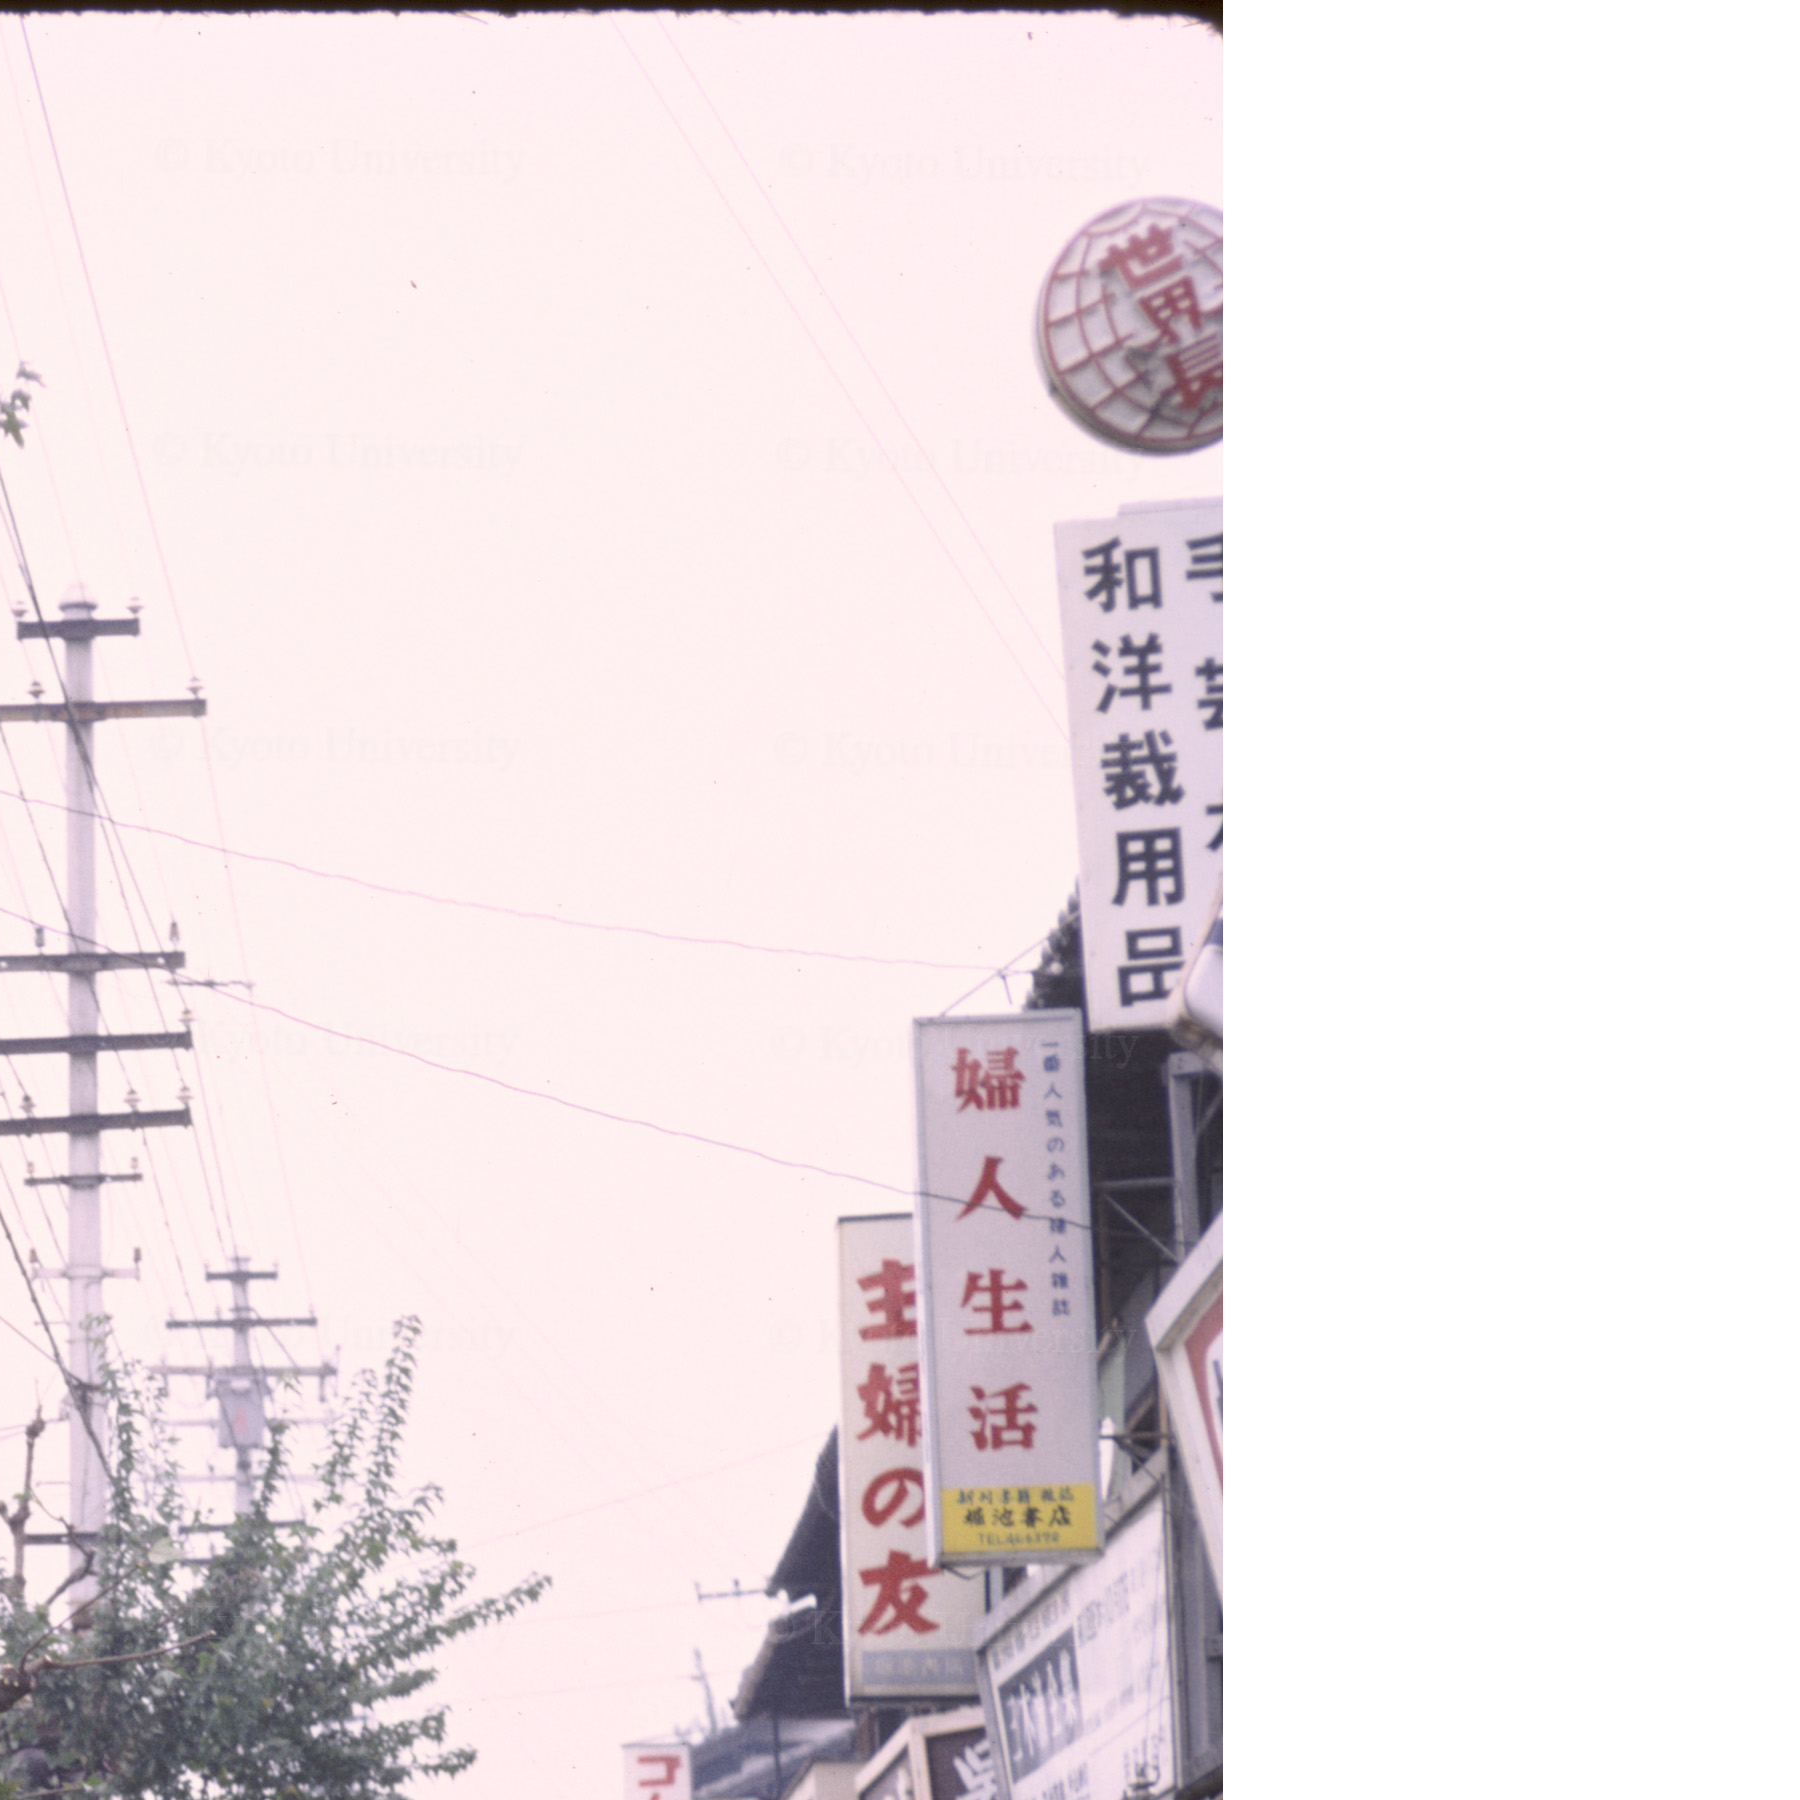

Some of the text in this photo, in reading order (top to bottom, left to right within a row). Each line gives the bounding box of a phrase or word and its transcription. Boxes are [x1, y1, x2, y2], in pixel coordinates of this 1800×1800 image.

[1082, 536, 1185, 1007] 和洋裁用品
[856, 1259, 940, 1635] 主婦の友
[951, 1046, 1038, 1451] 婦人生活
